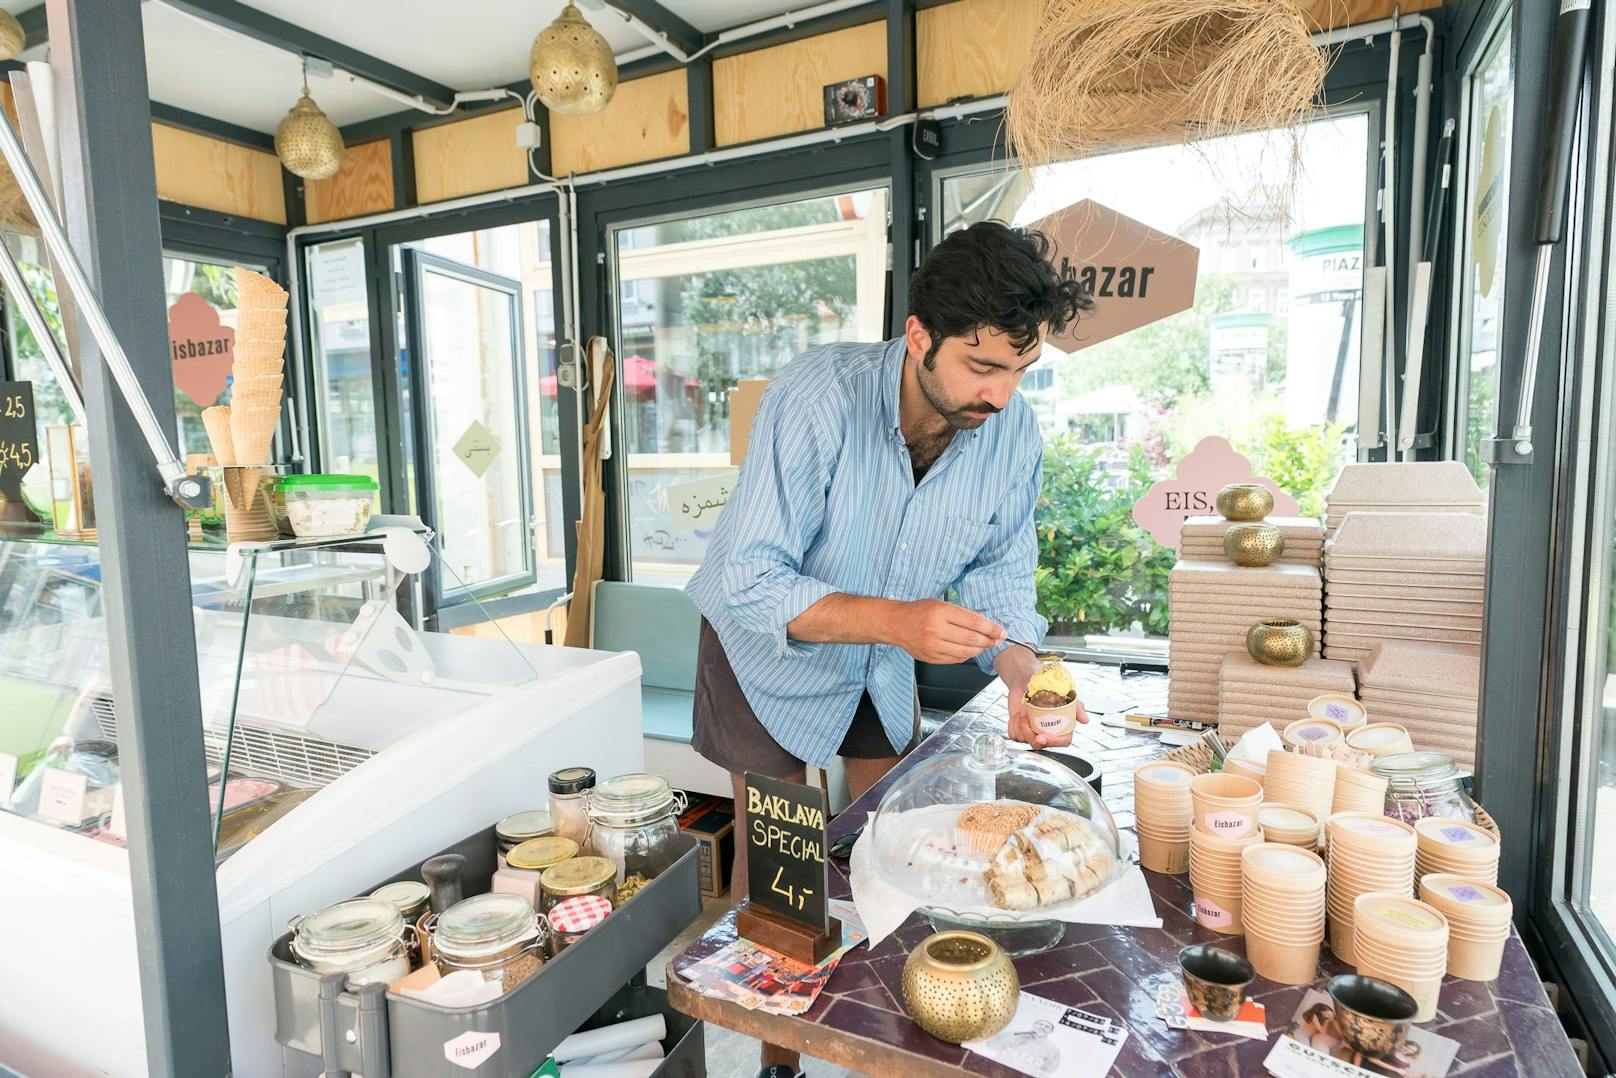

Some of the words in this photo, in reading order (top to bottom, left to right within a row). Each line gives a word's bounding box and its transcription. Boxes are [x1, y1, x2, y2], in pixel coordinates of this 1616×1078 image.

[1322, 256, 1360, 275] PIAZ
[1061, 257, 1155, 298] bazar
[172, 338, 230, 360] isbazar
[682, 487, 728, 519] شمزه
[1165, 491, 1214, 513] EIS,
[747, 786, 824, 830] BAKLAVA
[1214, 820, 1243, 829] Eisbazar
[752, 819, 825, 863] SPECIAL
[1197, 903, 1221, 918] Eisbazar
[455, 1040, 487, 1057] Eisbazar
